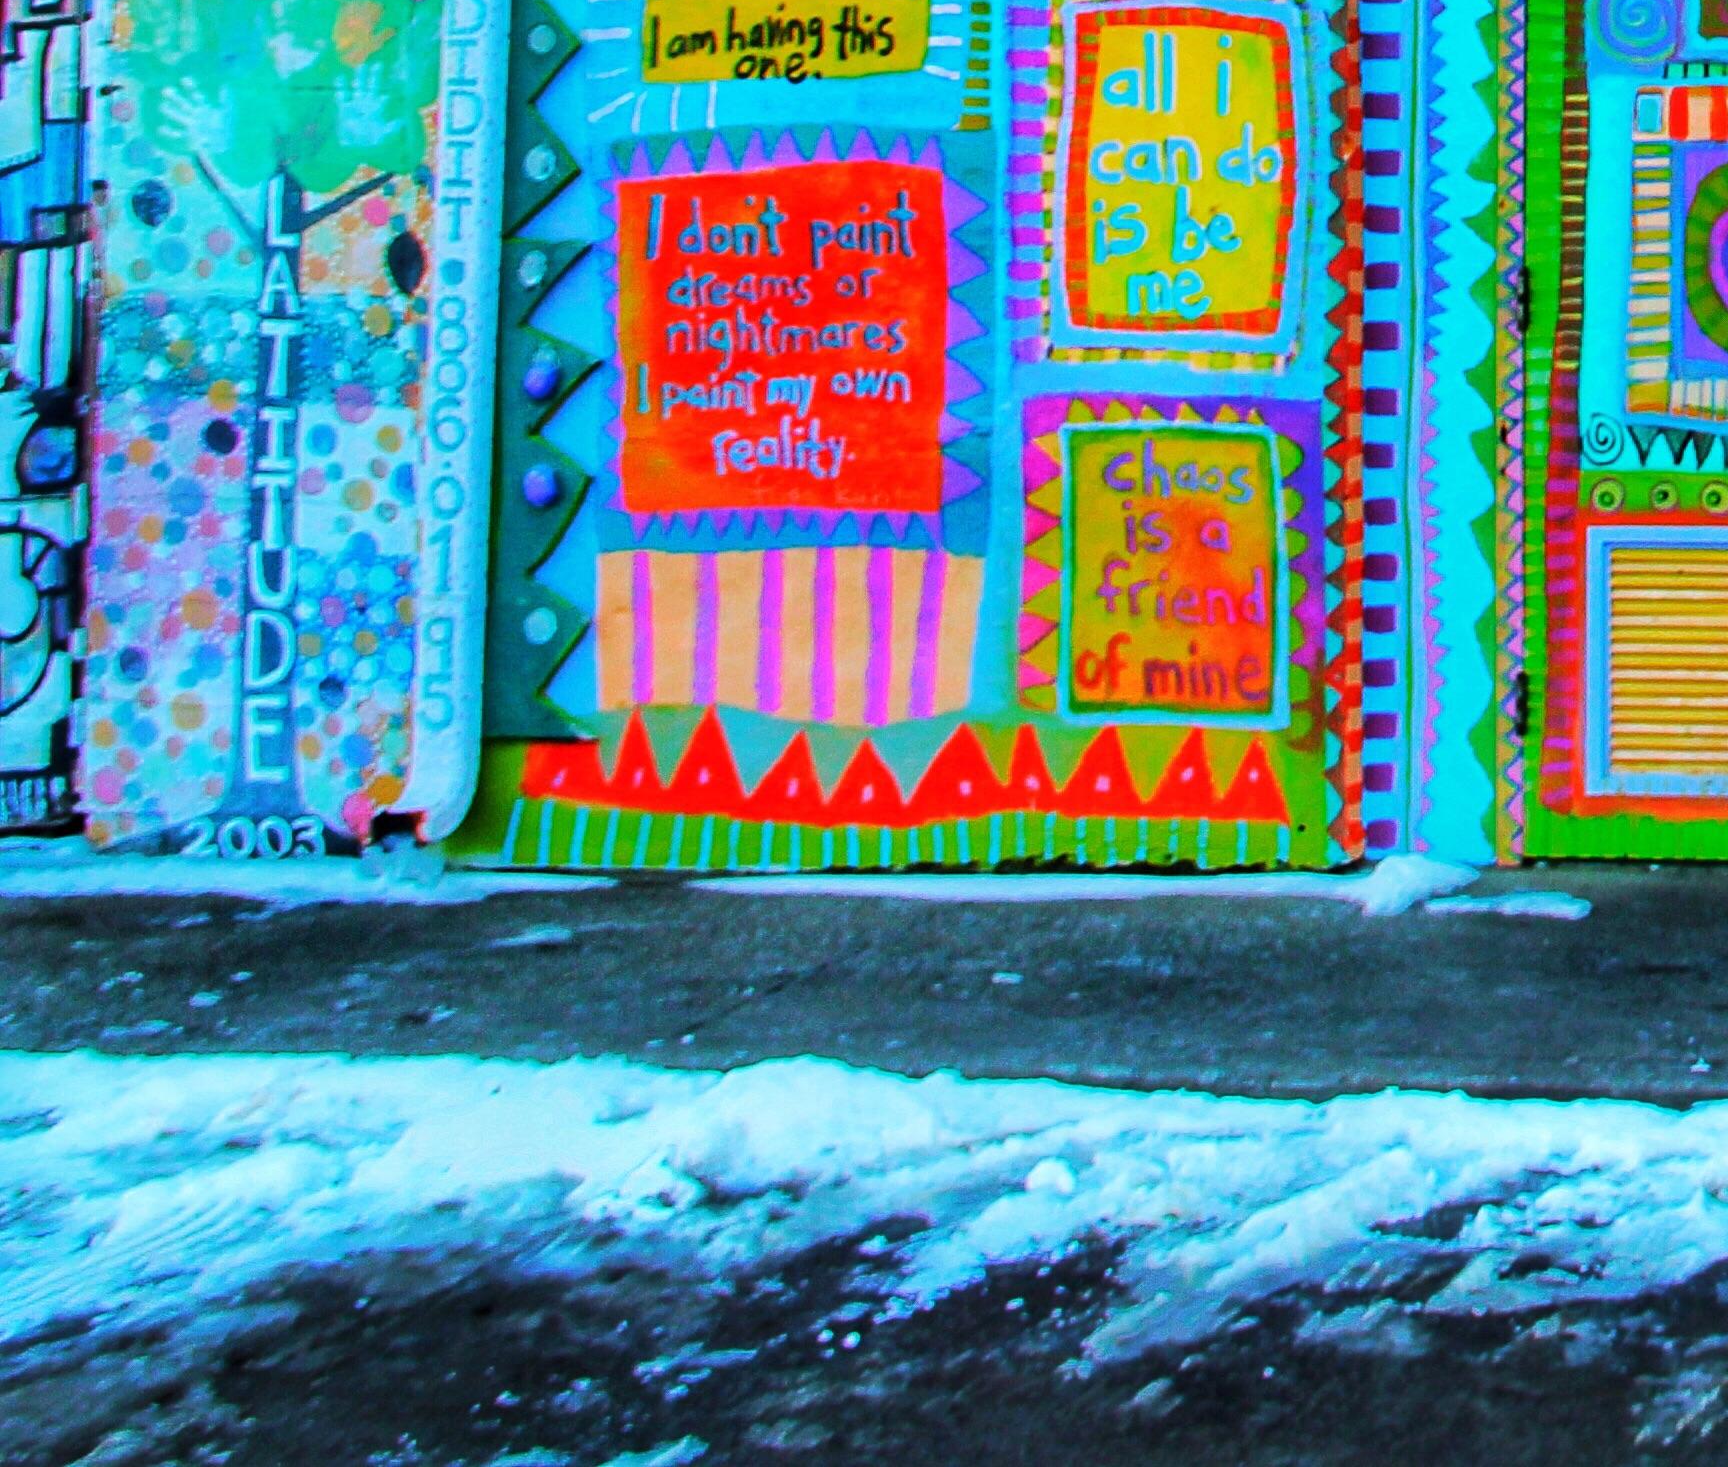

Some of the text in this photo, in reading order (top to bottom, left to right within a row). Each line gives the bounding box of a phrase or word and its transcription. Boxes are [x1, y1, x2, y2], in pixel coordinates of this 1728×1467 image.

[649, 4, 896, 68] I am having this
[734, 51, 823, 84] one.
[1102, 31, 1233, 116] all i
[1089, 122, 1284, 187] can do
[645, 189, 918, 269] I don't paint
[1092, 185, 1243, 264] is be
[666, 265, 884, 308] dreams or
[1126, 268, 1212, 320] me
[665, 305, 909, 372] nightmares
[636, 363, 912, 420] I paint my own
[245, 173, 301, 782] LATITUDE
[1103, 439, 1255, 504] Chaos
[1121, 499, 1232, 554] is a
[1097, 558, 1269, 629] friend
[1074, 632, 1269, 703] of mine
[179, 815, 327, 861] 2003
